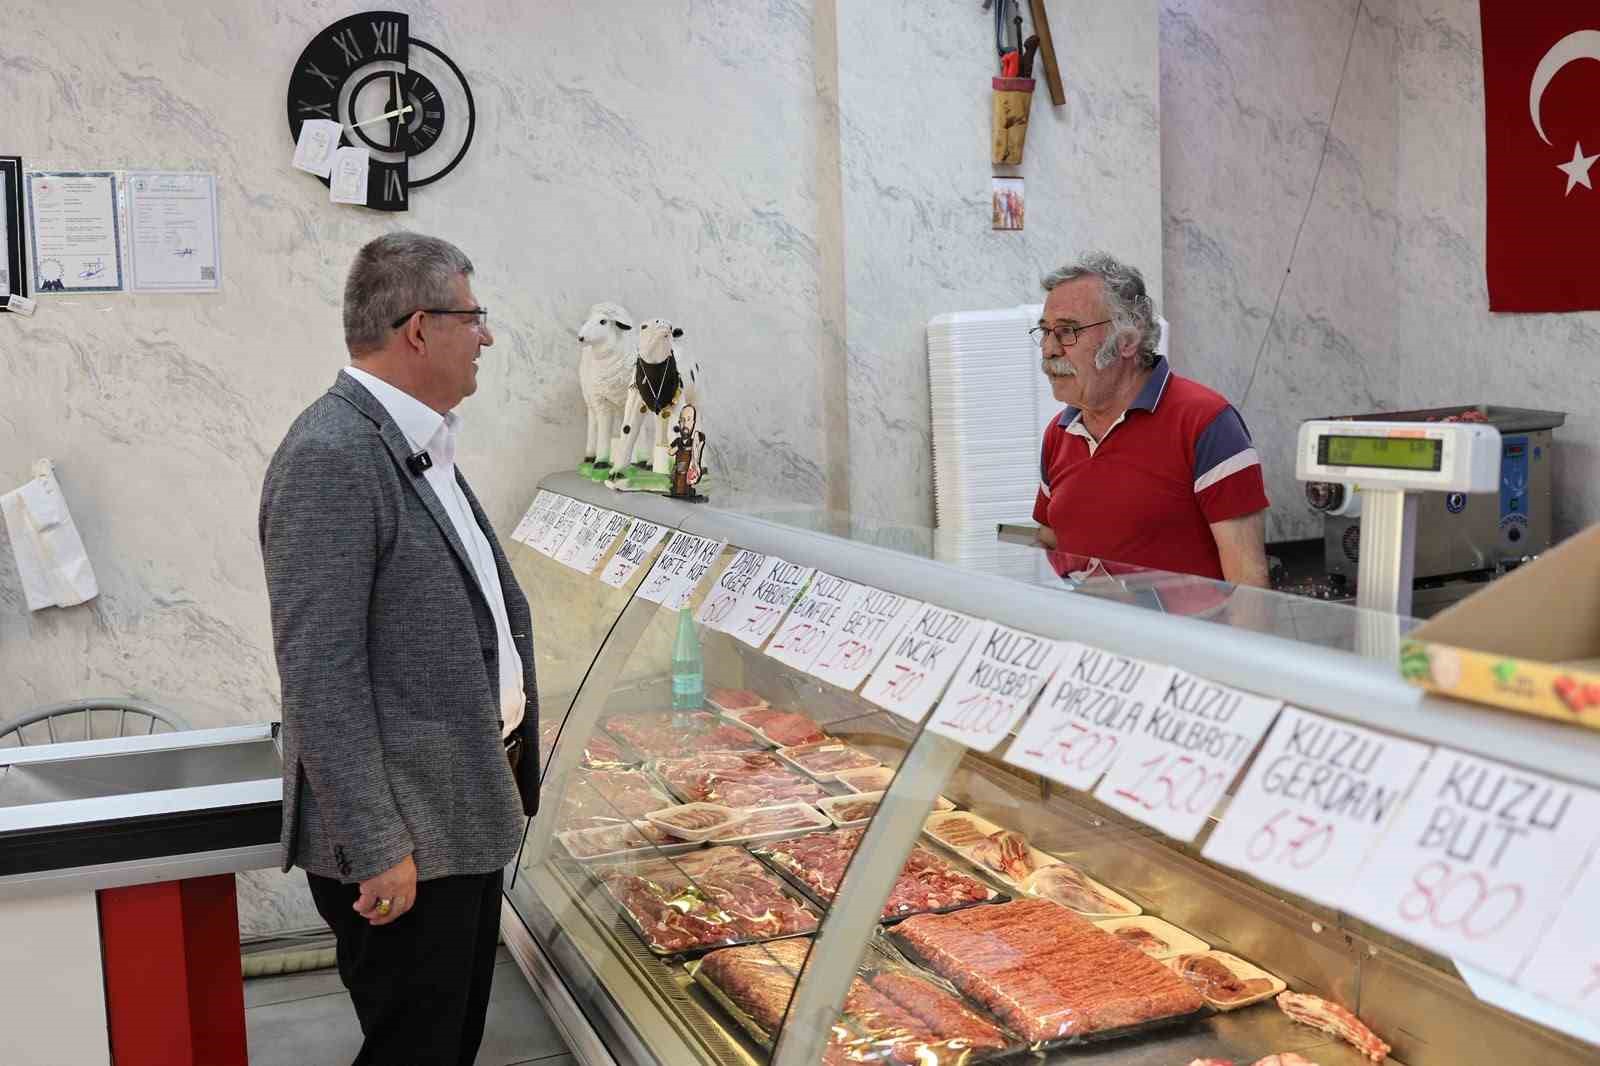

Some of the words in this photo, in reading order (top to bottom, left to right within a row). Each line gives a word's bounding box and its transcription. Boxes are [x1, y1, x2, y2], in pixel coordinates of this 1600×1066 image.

[332, 28, 364, 67] XI
[371, 21, 399, 55] XII
[305, 62, 339, 88] X
[297, 100, 332, 117] X
[384, 169, 404, 201] VI
[731, 551, 766, 576] DANA
[768, 561, 803, 586] KUZU
[813, 574, 852, 602] KUZU
[864, 590, 906, 619] KUZU
[914, 608, 969, 645] KUZU
[981, 626, 1055, 674] KUZU
[1071, 648, 1146, 696] KUZU
[1162, 673, 1244, 723] KUZU
[1284, 717, 1386, 775] KUZU
[1115, 755, 1227, 816] 1500
[1260, 754, 1399, 824] GERDAN
[1437, 758, 1574, 832] KUZU
[1245, 808, 1335, 869] 670
[1417, 804, 1529, 869] BUT
[1397, 860, 1526, 942] 800
